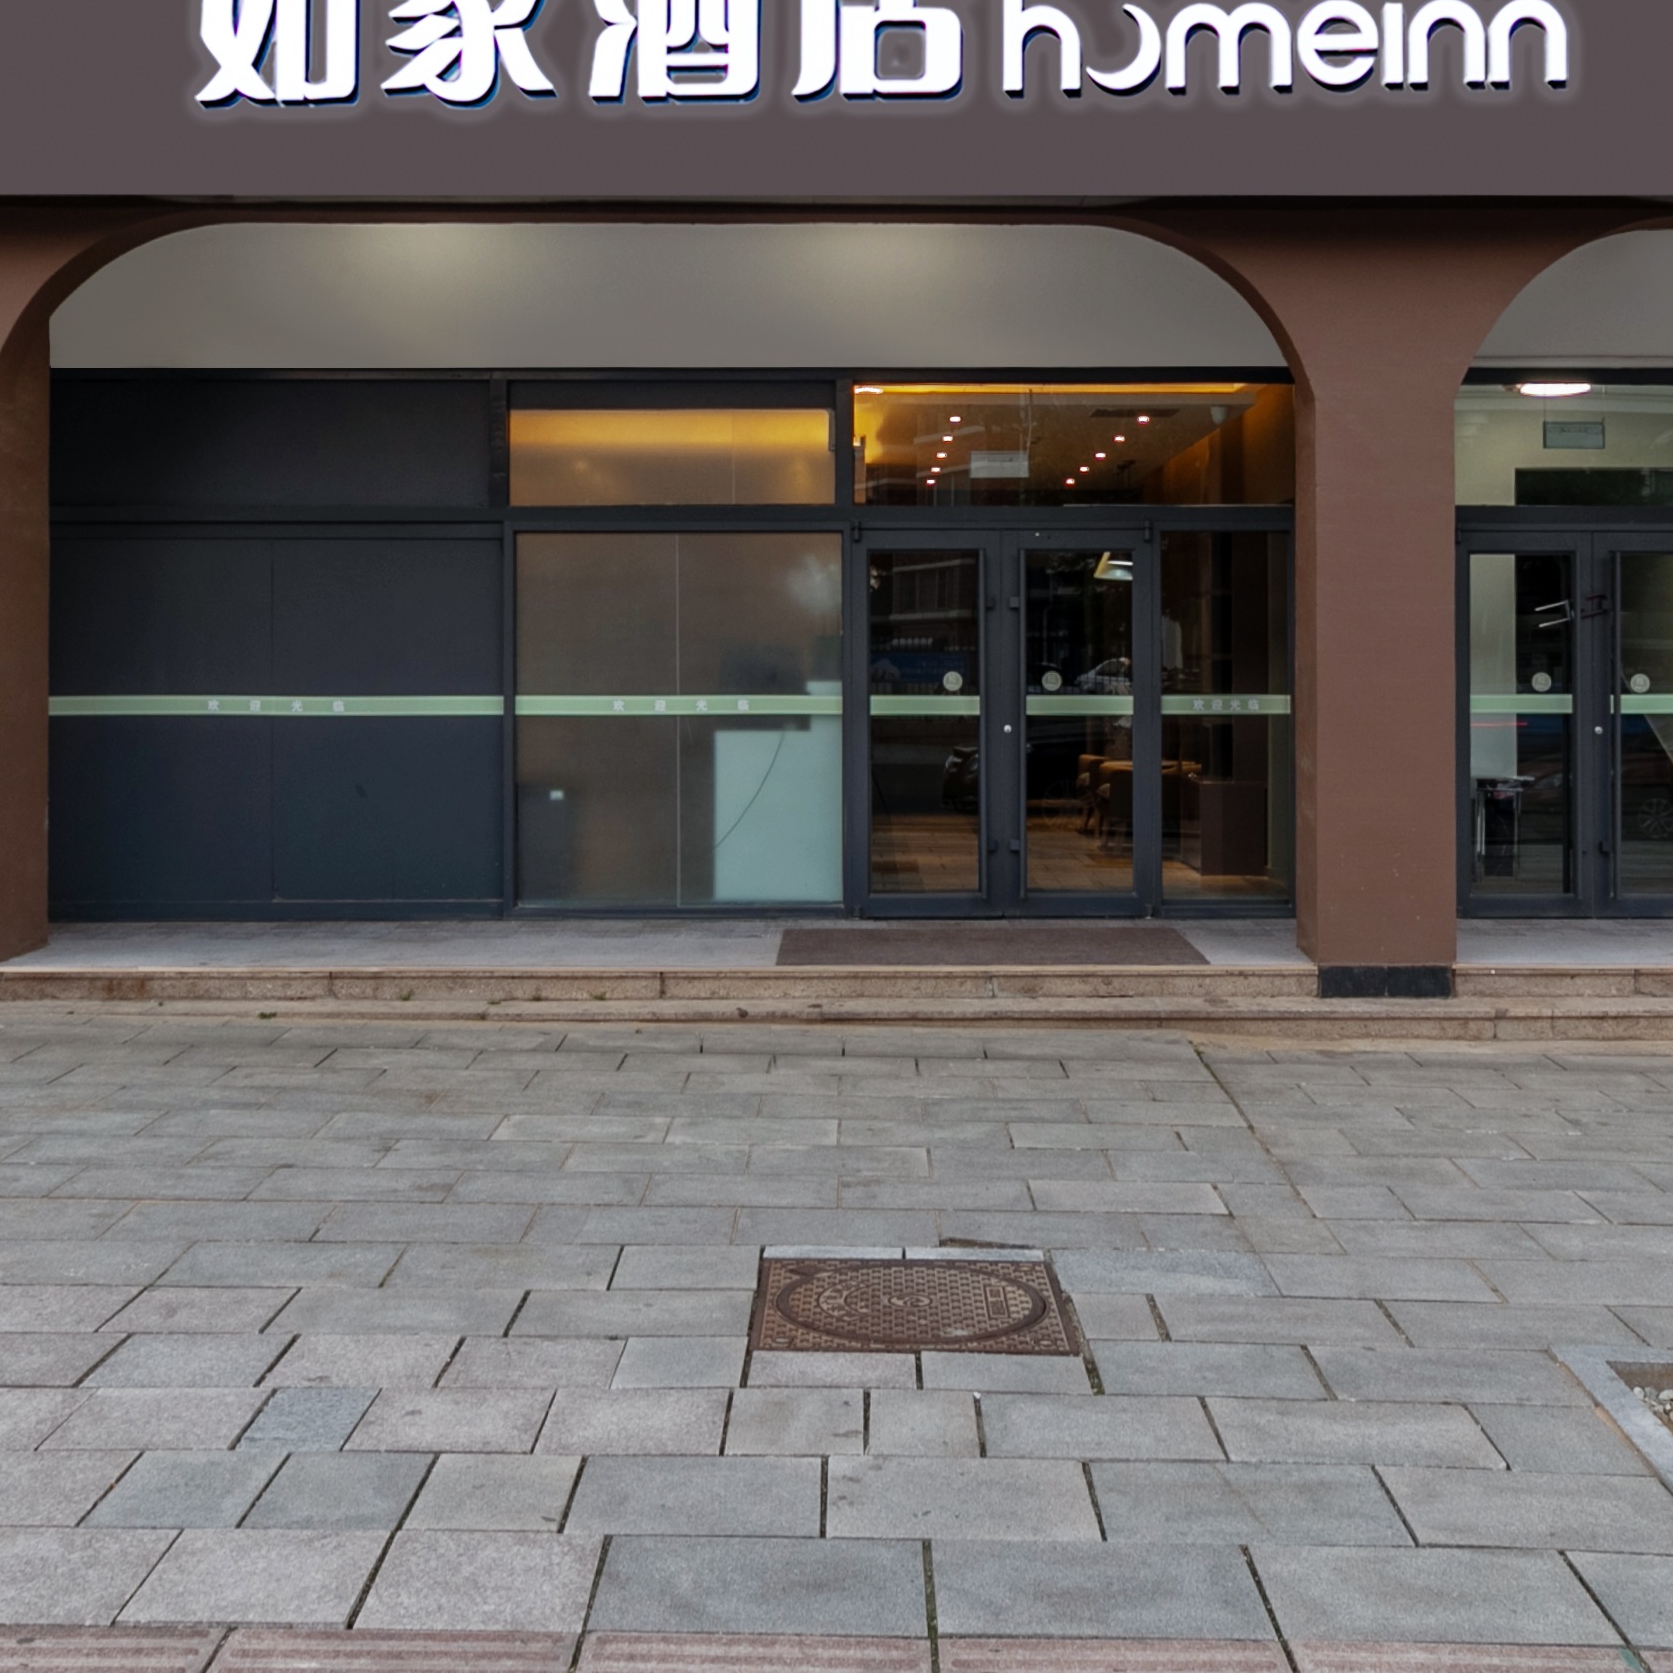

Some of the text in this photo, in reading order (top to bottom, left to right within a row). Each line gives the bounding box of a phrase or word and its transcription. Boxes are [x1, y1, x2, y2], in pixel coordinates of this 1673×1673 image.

[207, 699, 345, 712] 欢迎光临
[612, 699, 749, 712] 欢迎光临
[1192, 698, 1260, 711] 欢迎光临
